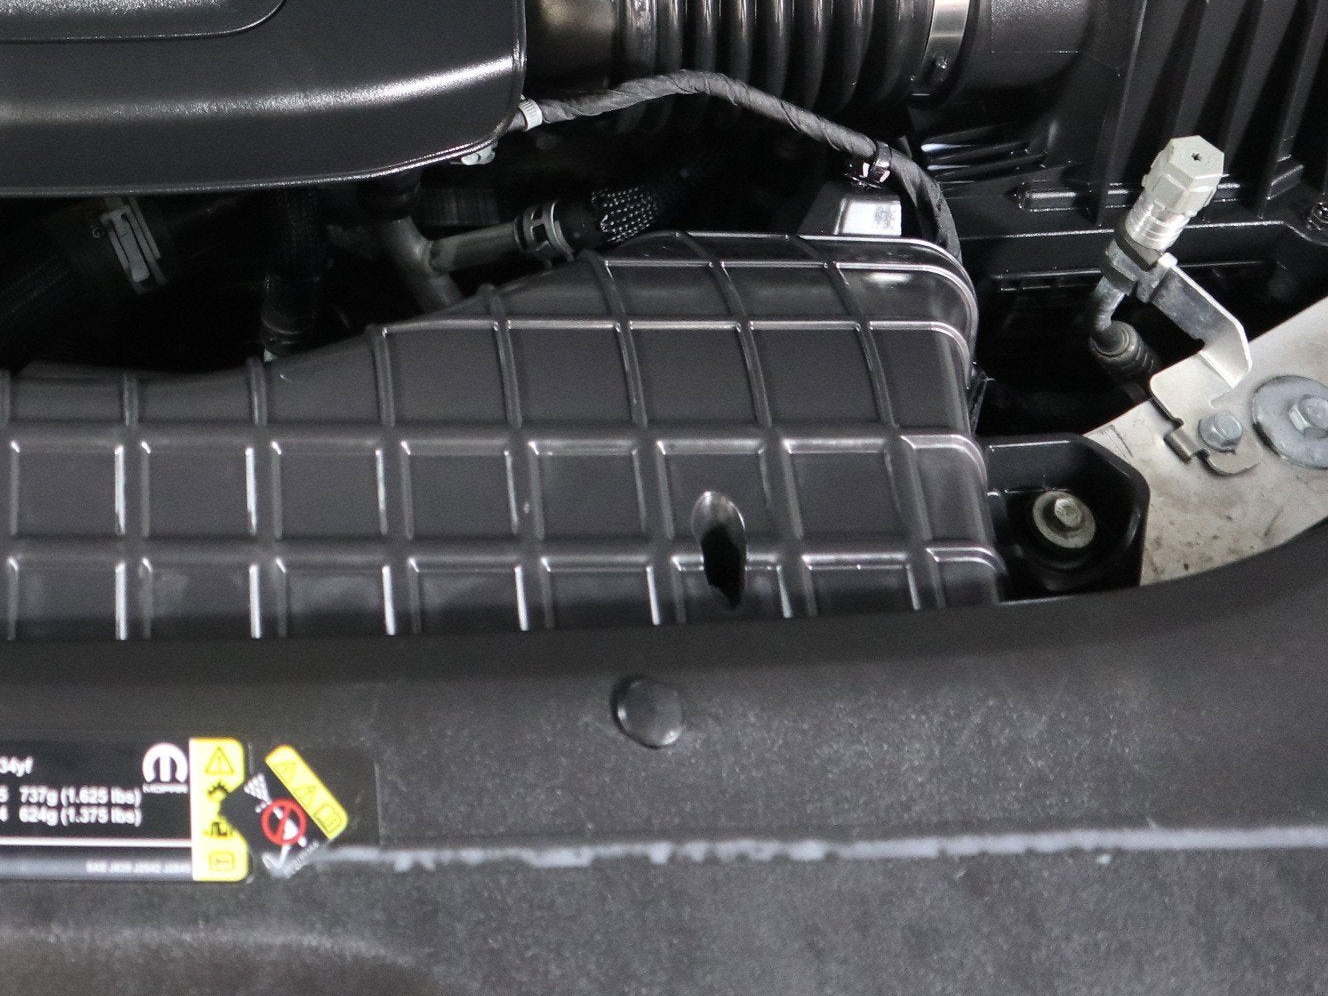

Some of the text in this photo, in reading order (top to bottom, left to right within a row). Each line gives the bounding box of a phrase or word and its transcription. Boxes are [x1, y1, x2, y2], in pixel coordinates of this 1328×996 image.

[19, 785, 59, 807] 737g
[60, 786, 108, 807] (1.625
[110, 787, 143, 808] lbs)
[19, 806, 59, 826] 624g
[60, 806, 108, 827] (1.375
[110, 806, 143, 828] lbs)
